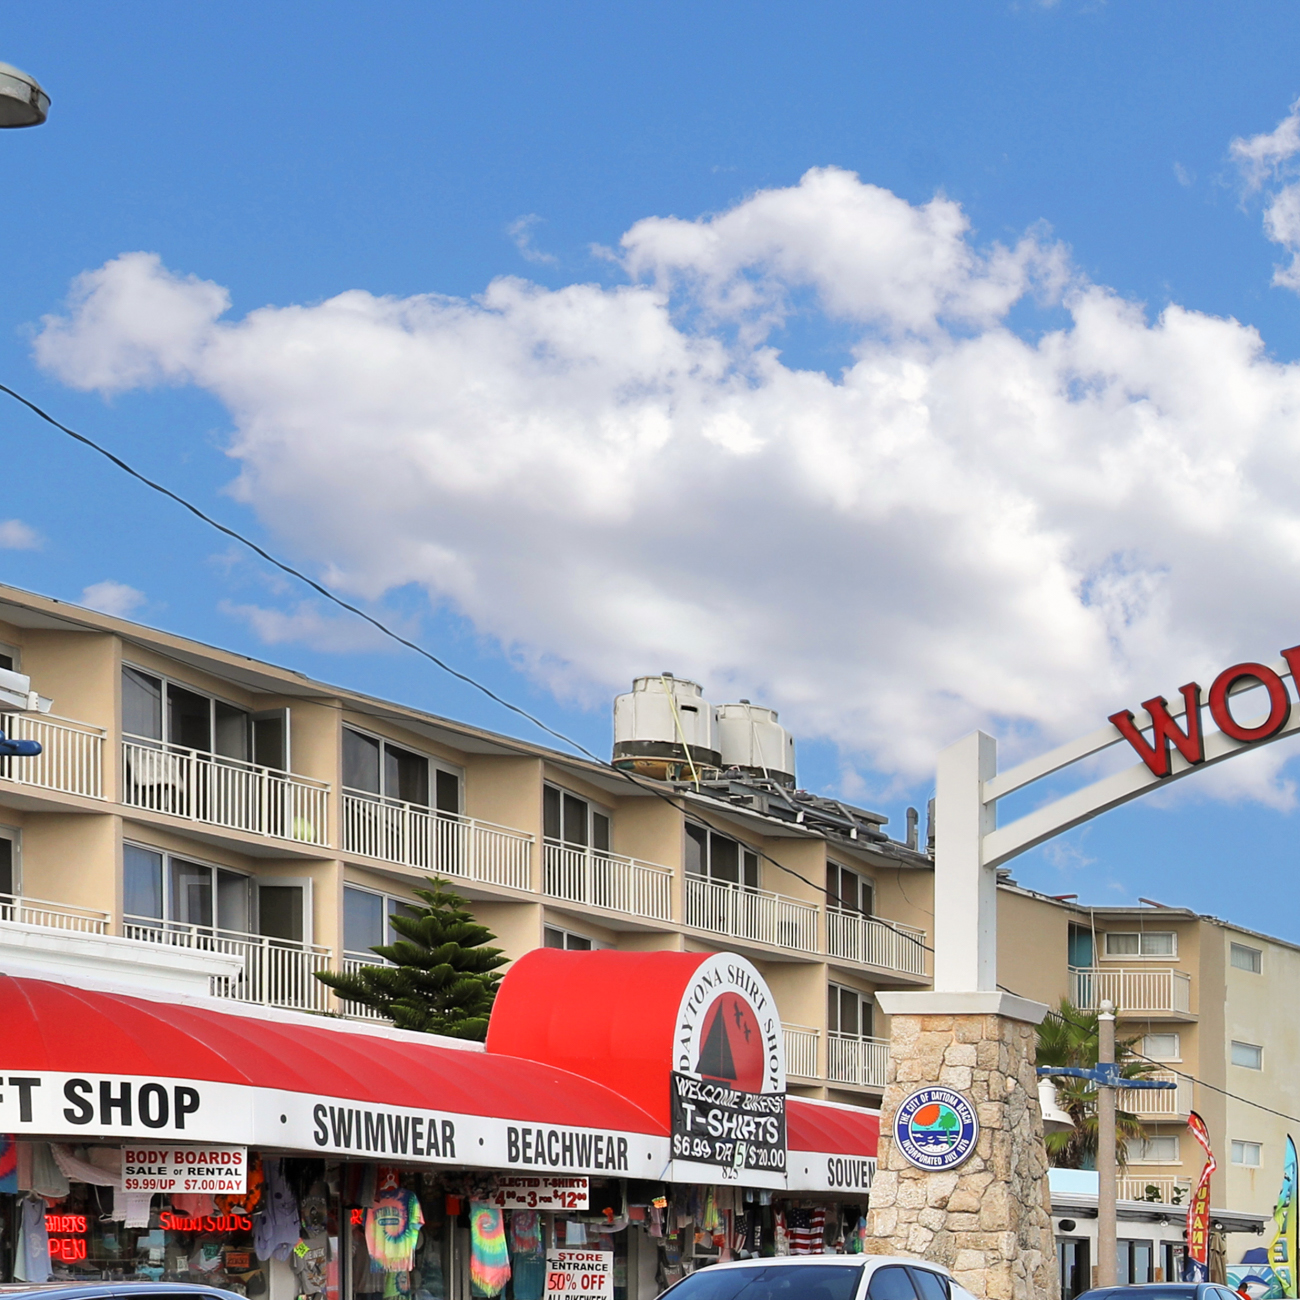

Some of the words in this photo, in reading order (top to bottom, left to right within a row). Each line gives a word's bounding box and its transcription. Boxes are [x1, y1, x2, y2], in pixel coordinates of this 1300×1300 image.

[679, 967, 723, 1072] DAYTONA
[727, 964, 767, 1012] SHIRT
[764, 1018, 779, 1091] SHOP
[63, 1078, 200, 1129] SHOP
[675, 1076, 741, 1108] WELCOME
[899, 1112, 911, 1125] THE
[906, 1097, 920, 1113] CITY
[920, 1093, 929, 1103] OF
[931, 1091, 958, 1106] DAYTONA
[956, 1102, 972, 1125] BEACH
[313, 1104, 456, 1158] SWIMWEAR
[682, 1103, 779, 1144] T-SHIRTS
[125, 1151, 169, 1164] BODY
[174, 1151, 242, 1165] BOARDS
[507, 1126, 629, 1171] BEACHWEAR
[673, 1133, 712, 1158] $6.99
[715, 1142, 733, 1161] OR
[902, 1139, 942, 1165] INCORPORATED
[944, 1151, 958, 1164] JULY
[956, 1139, 970, 1153] 1876
[125, 1166, 167, 1175] SALE
[188, 1167, 242, 1176] RENTAL
[543, 1178, 588, 1188] T-SHIRTS
[125, 1179, 176, 1190] $9.99/UP
[184, 1179, 242, 1190] $7.00/DAY
[527, 1191, 537, 1207] 3
[47, 1238, 88, 1260] PEN
[558, 1252, 603, 1261] STORE
[552, 1262, 608, 1271] ENTRANCE
[548, 1273, 576, 1290] 50%
[581, 1274, 605, 1290] OFF
